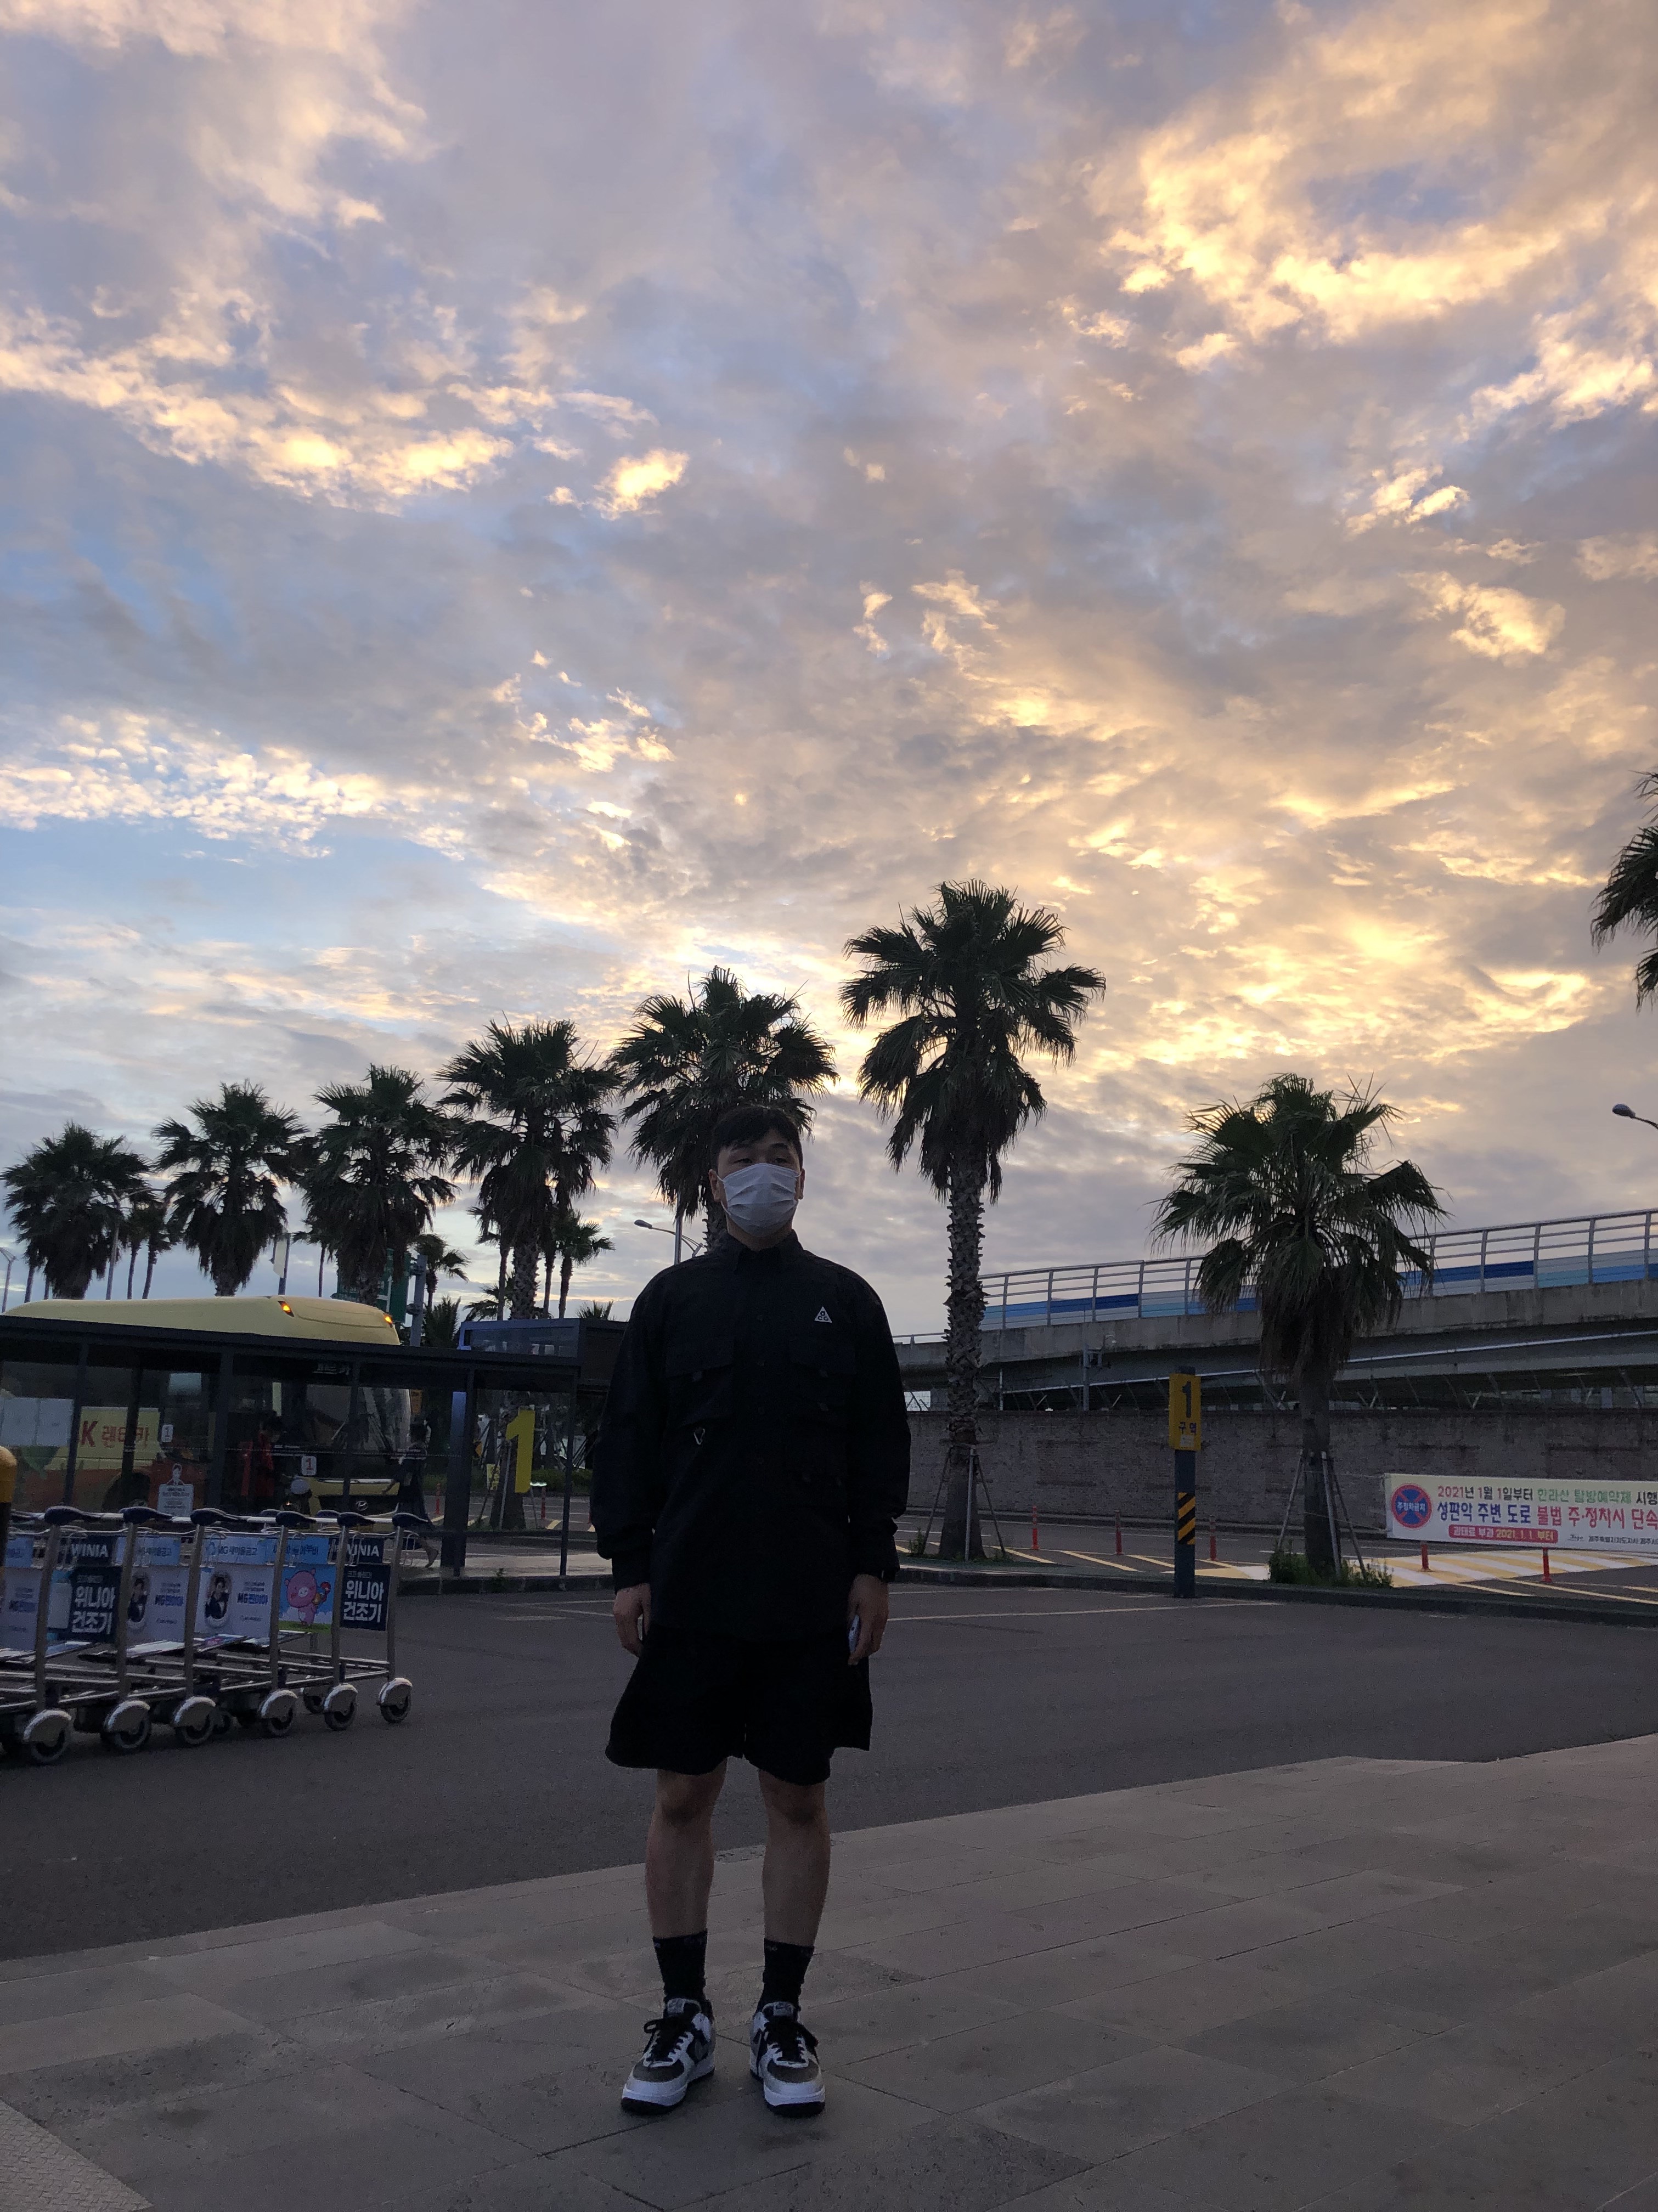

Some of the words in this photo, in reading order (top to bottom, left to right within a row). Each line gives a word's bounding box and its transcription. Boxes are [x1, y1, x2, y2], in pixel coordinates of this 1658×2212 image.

[1182, 1381, 1192, 1418] 1
[506, 1409, 535, 1493] 1
[1437, 1486, 1474, 1499] 2021년
[1477, 1486, 1493, 1500] 1월
[1497, 1487, 1533, 1501] 1일부터
[1537, 1488, 1569, 1503] 한라산
[1636, 1491, 1658, 1505] 시행
[1437, 1501, 1473, 1522] 성판악
[1477, 1503, 1501, 1523] 주변
[1508, 1504, 1531, 1523] 도로
[1537, 1505, 1561, 1526] 불법
[1631, 1508, 1658, 1530] 단속
[71, 1543, 109, 1557] WINIA
[75, 1585, 116, 1609] 위니아
[345, 1580, 384, 1601] 위니아
[72, 1611, 112, 1634] 건조기
[343, 1601, 382, 1623] 건조기
